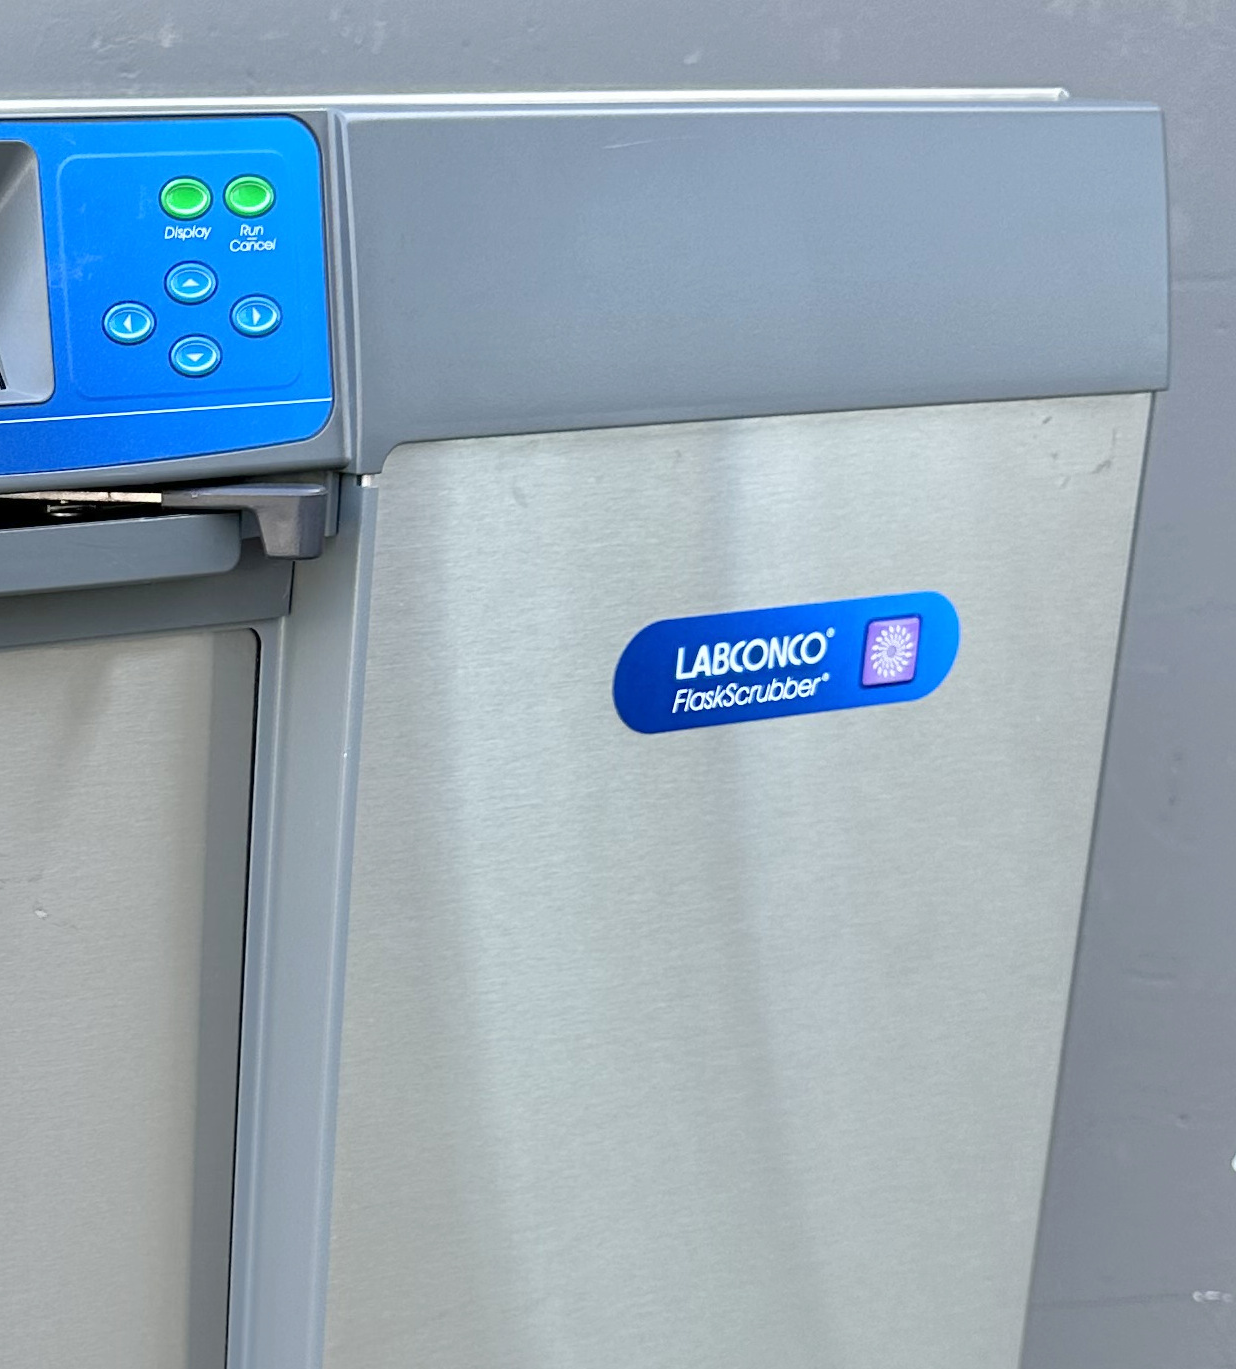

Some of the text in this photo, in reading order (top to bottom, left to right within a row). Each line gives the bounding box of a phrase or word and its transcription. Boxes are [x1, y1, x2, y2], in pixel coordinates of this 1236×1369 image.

[164, 224, 212, 241] Display
[239, 224, 264, 237] Run
[229, 237, 276, 252] Cancel
